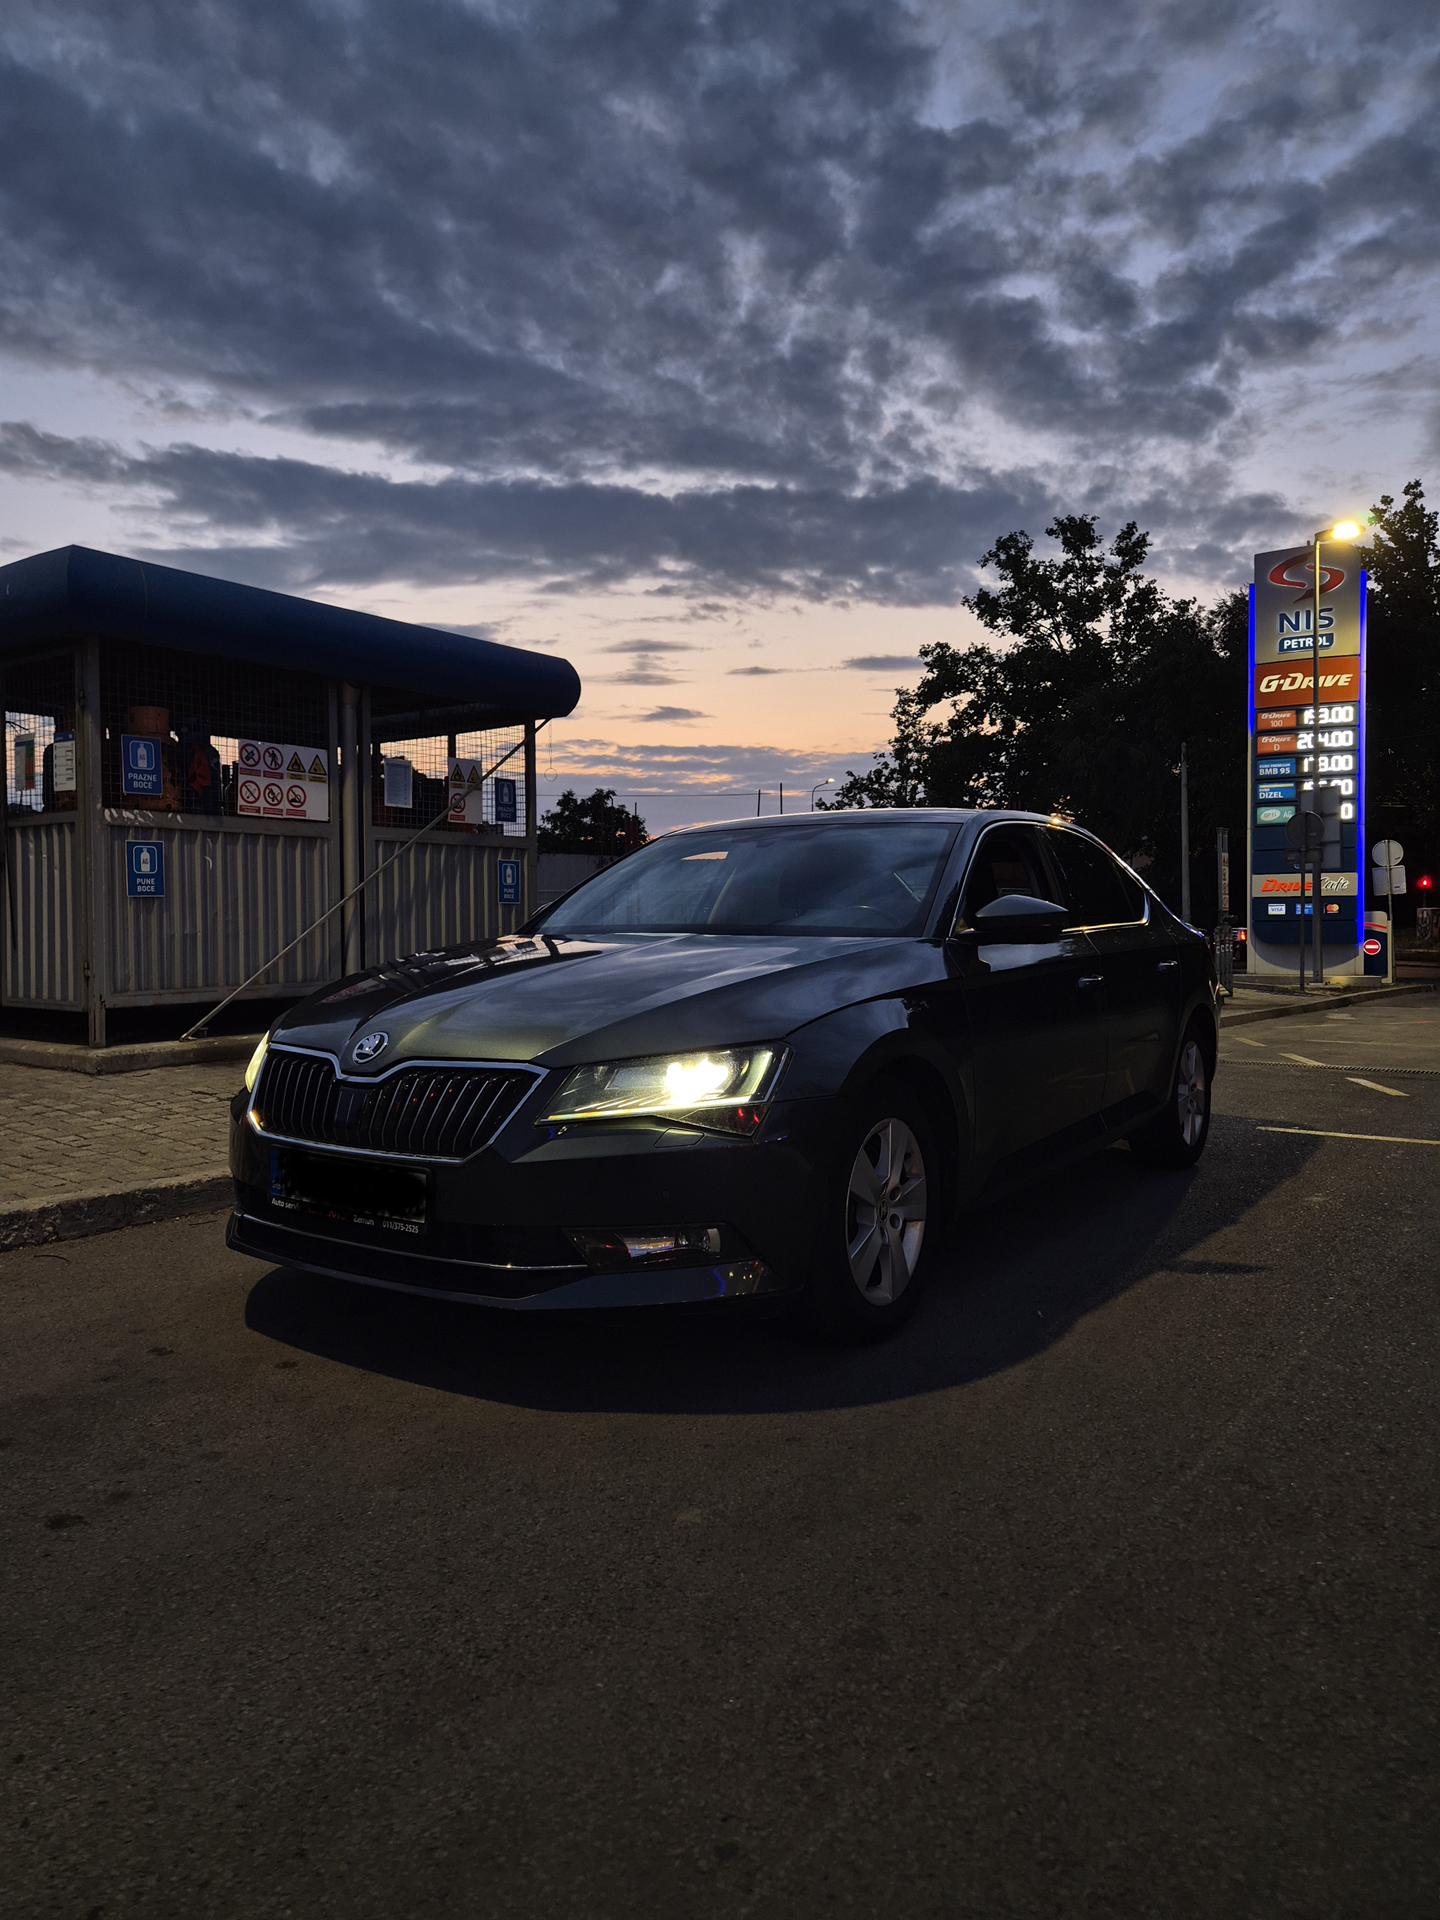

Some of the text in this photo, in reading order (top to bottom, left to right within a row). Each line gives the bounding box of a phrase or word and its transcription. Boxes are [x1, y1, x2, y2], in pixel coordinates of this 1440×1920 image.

[1279, 608, 1334, 634] NIS
[1304, 755, 1353, 773] 18.00
[128, 772, 158, 782] PRAZNE
[1259, 767, 1291, 776] BMB 95
[133, 780, 153, 789] BOCE
[1259, 791, 1284, 799] DIZEL
[1261, 878, 1313, 893] DRIVE
[271, 1198, 285, 1207] Auto
[353, 1214, 375, 1226] Zemun
[382, 1220, 419, 1233] 011/375-2525
